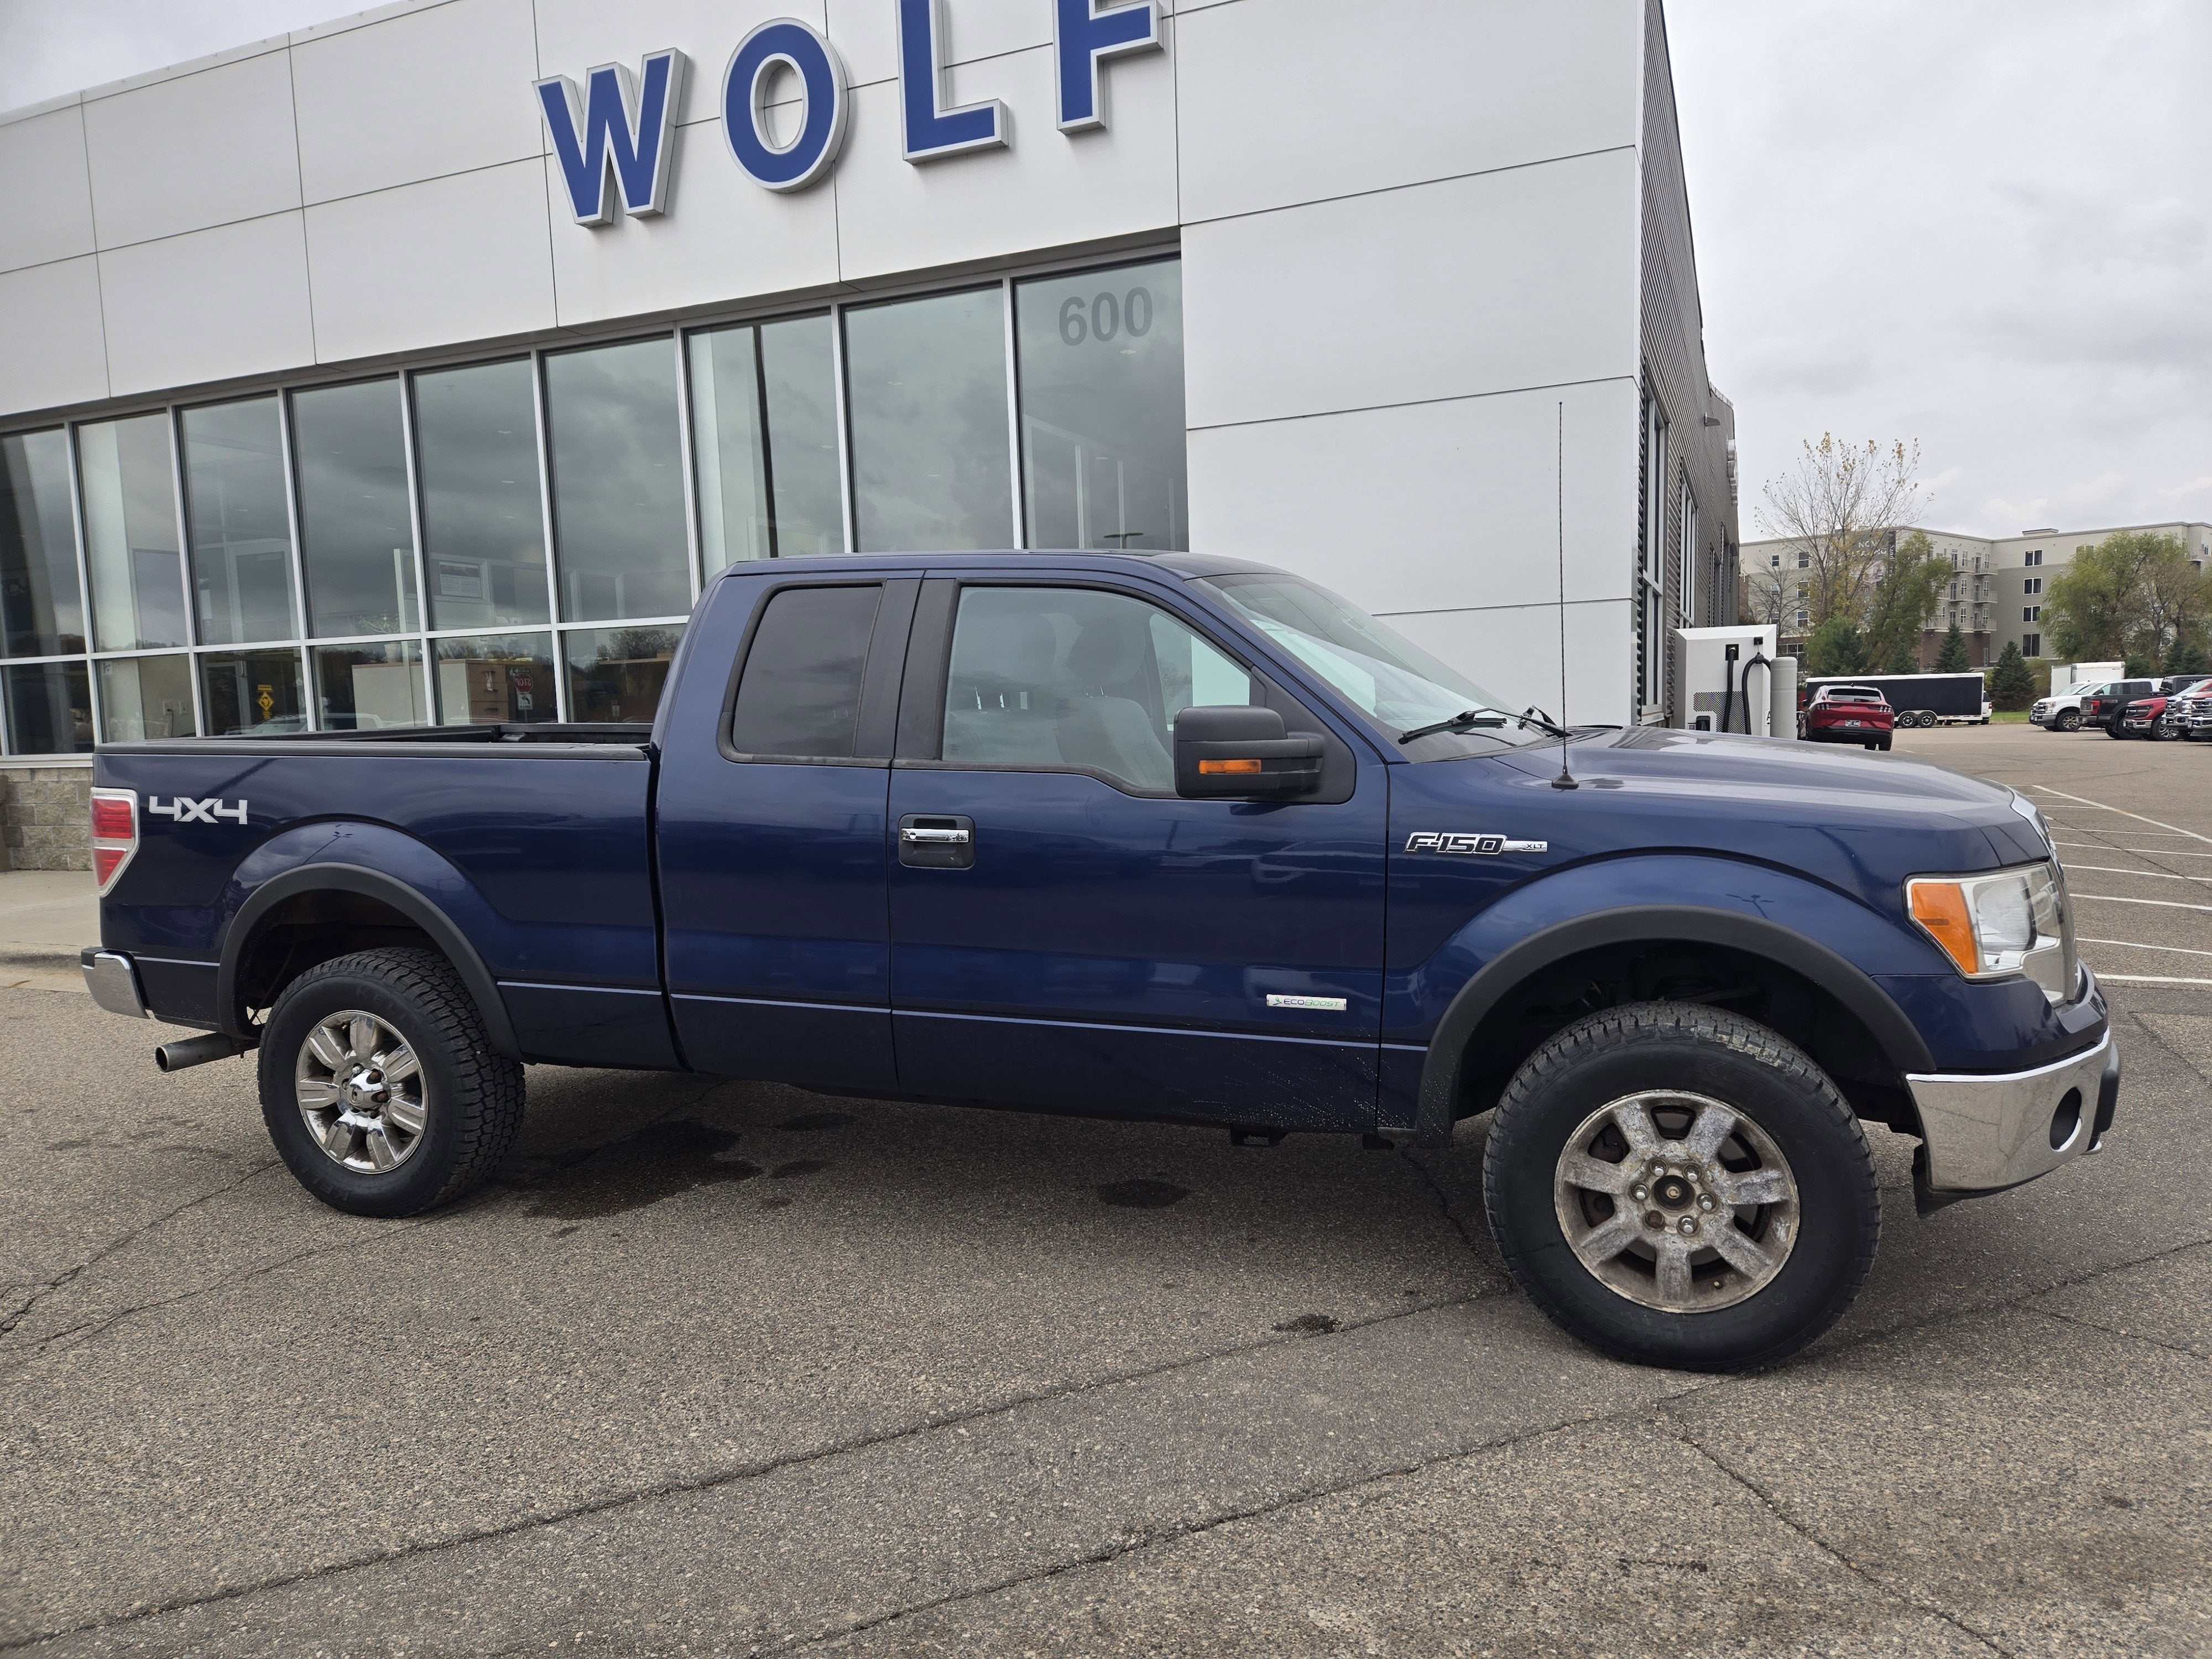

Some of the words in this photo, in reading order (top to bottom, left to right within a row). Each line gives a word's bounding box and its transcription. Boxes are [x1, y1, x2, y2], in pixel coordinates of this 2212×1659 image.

[533, 0, 1164, 227] WOLF
[1059, 286, 1153, 346] 600
[1403, 831, 1507, 855] F-150
[1284, 998, 1340, 1007] ECOBOOST
